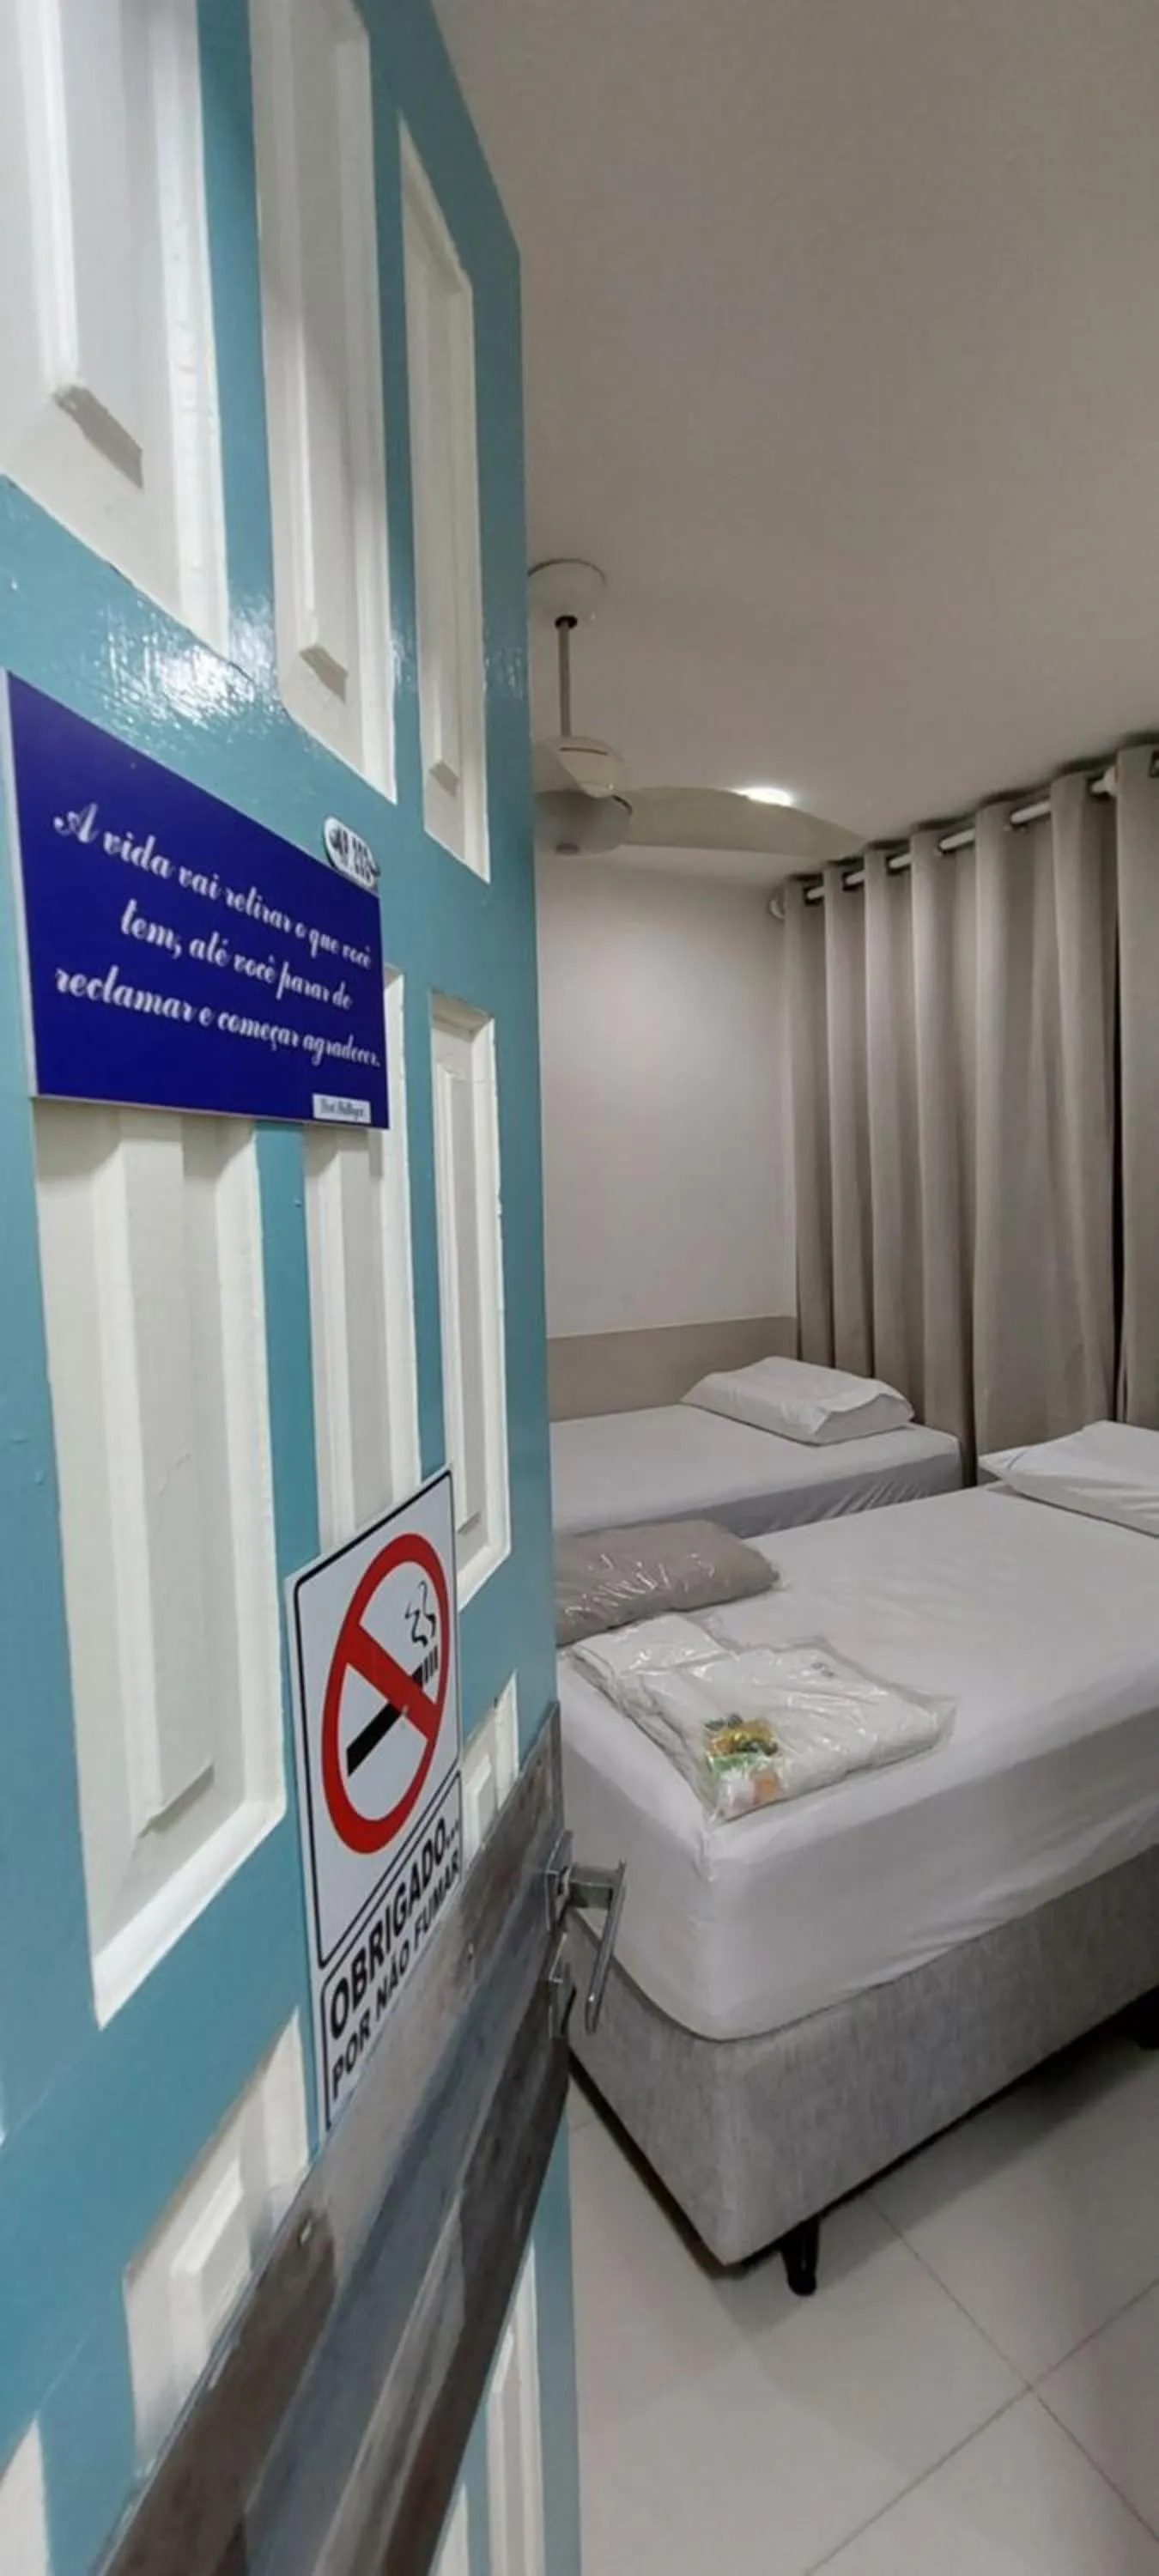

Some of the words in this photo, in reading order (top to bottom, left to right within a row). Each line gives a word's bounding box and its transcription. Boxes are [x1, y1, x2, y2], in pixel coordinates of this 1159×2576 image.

[53, 803, 100, 843] A
[103, 831, 174, 879] vida
[179, 866, 221, 901] vai
[225, 886, 293, 933] retirar
[294, 921, 307, 939] o
[308, 928, 339, 958] que
[343, 945, 372, 969] você
[121, 898, 182, 960] tem,
[189, 931, 232, 967] até
[233, 954, 276, 984] você
[276, 961, 330, 1003] parar
[332, 981, 353, 1010] de
[55, 964, 197, 1023] reclamar
[198, 1006, 215, 1027] e
[217, 1011, 300, 1052] começar
[302, 1034, 380, 1066] agradecer.
[331, 1818, 460, 2041] OBRIGADO...
[332, 2007, 370, 2100] POR
[376, 1939, 410, 2021] NÃO
[415, 1849, 458, 1952] FUMAR
